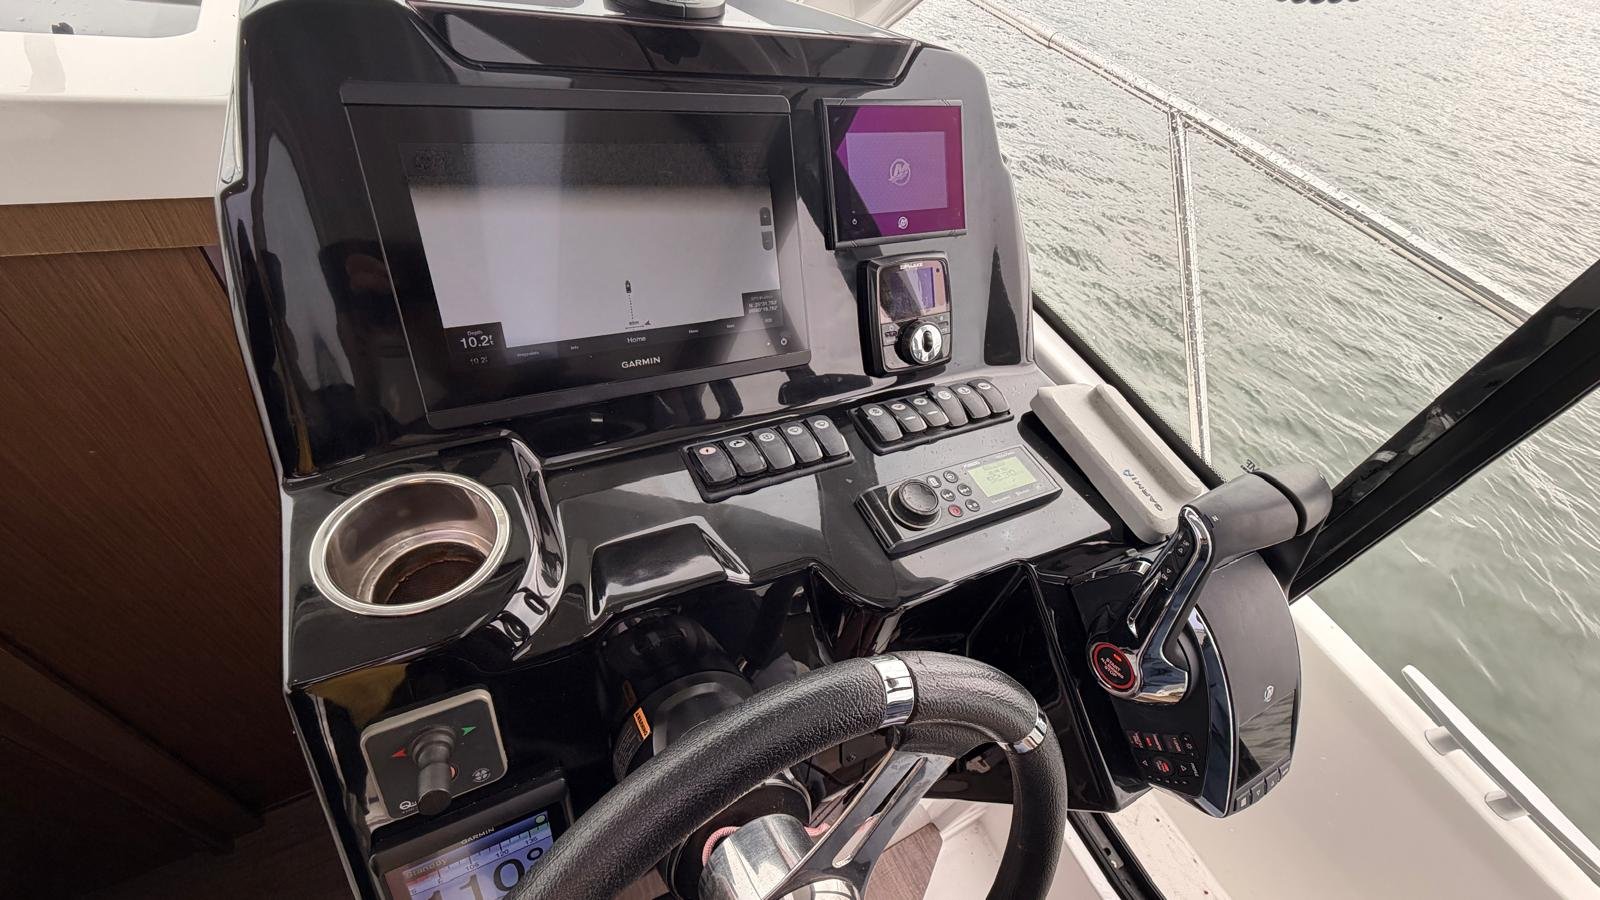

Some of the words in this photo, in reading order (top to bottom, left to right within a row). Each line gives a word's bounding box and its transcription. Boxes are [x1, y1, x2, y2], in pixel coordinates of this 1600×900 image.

[627, 335, 647, 344] Home
[621, 356, 661, 369] GARMIN
[1123, 469, 1163, 511] GARMIN
[460, 827, 495, 845] GARMIN
